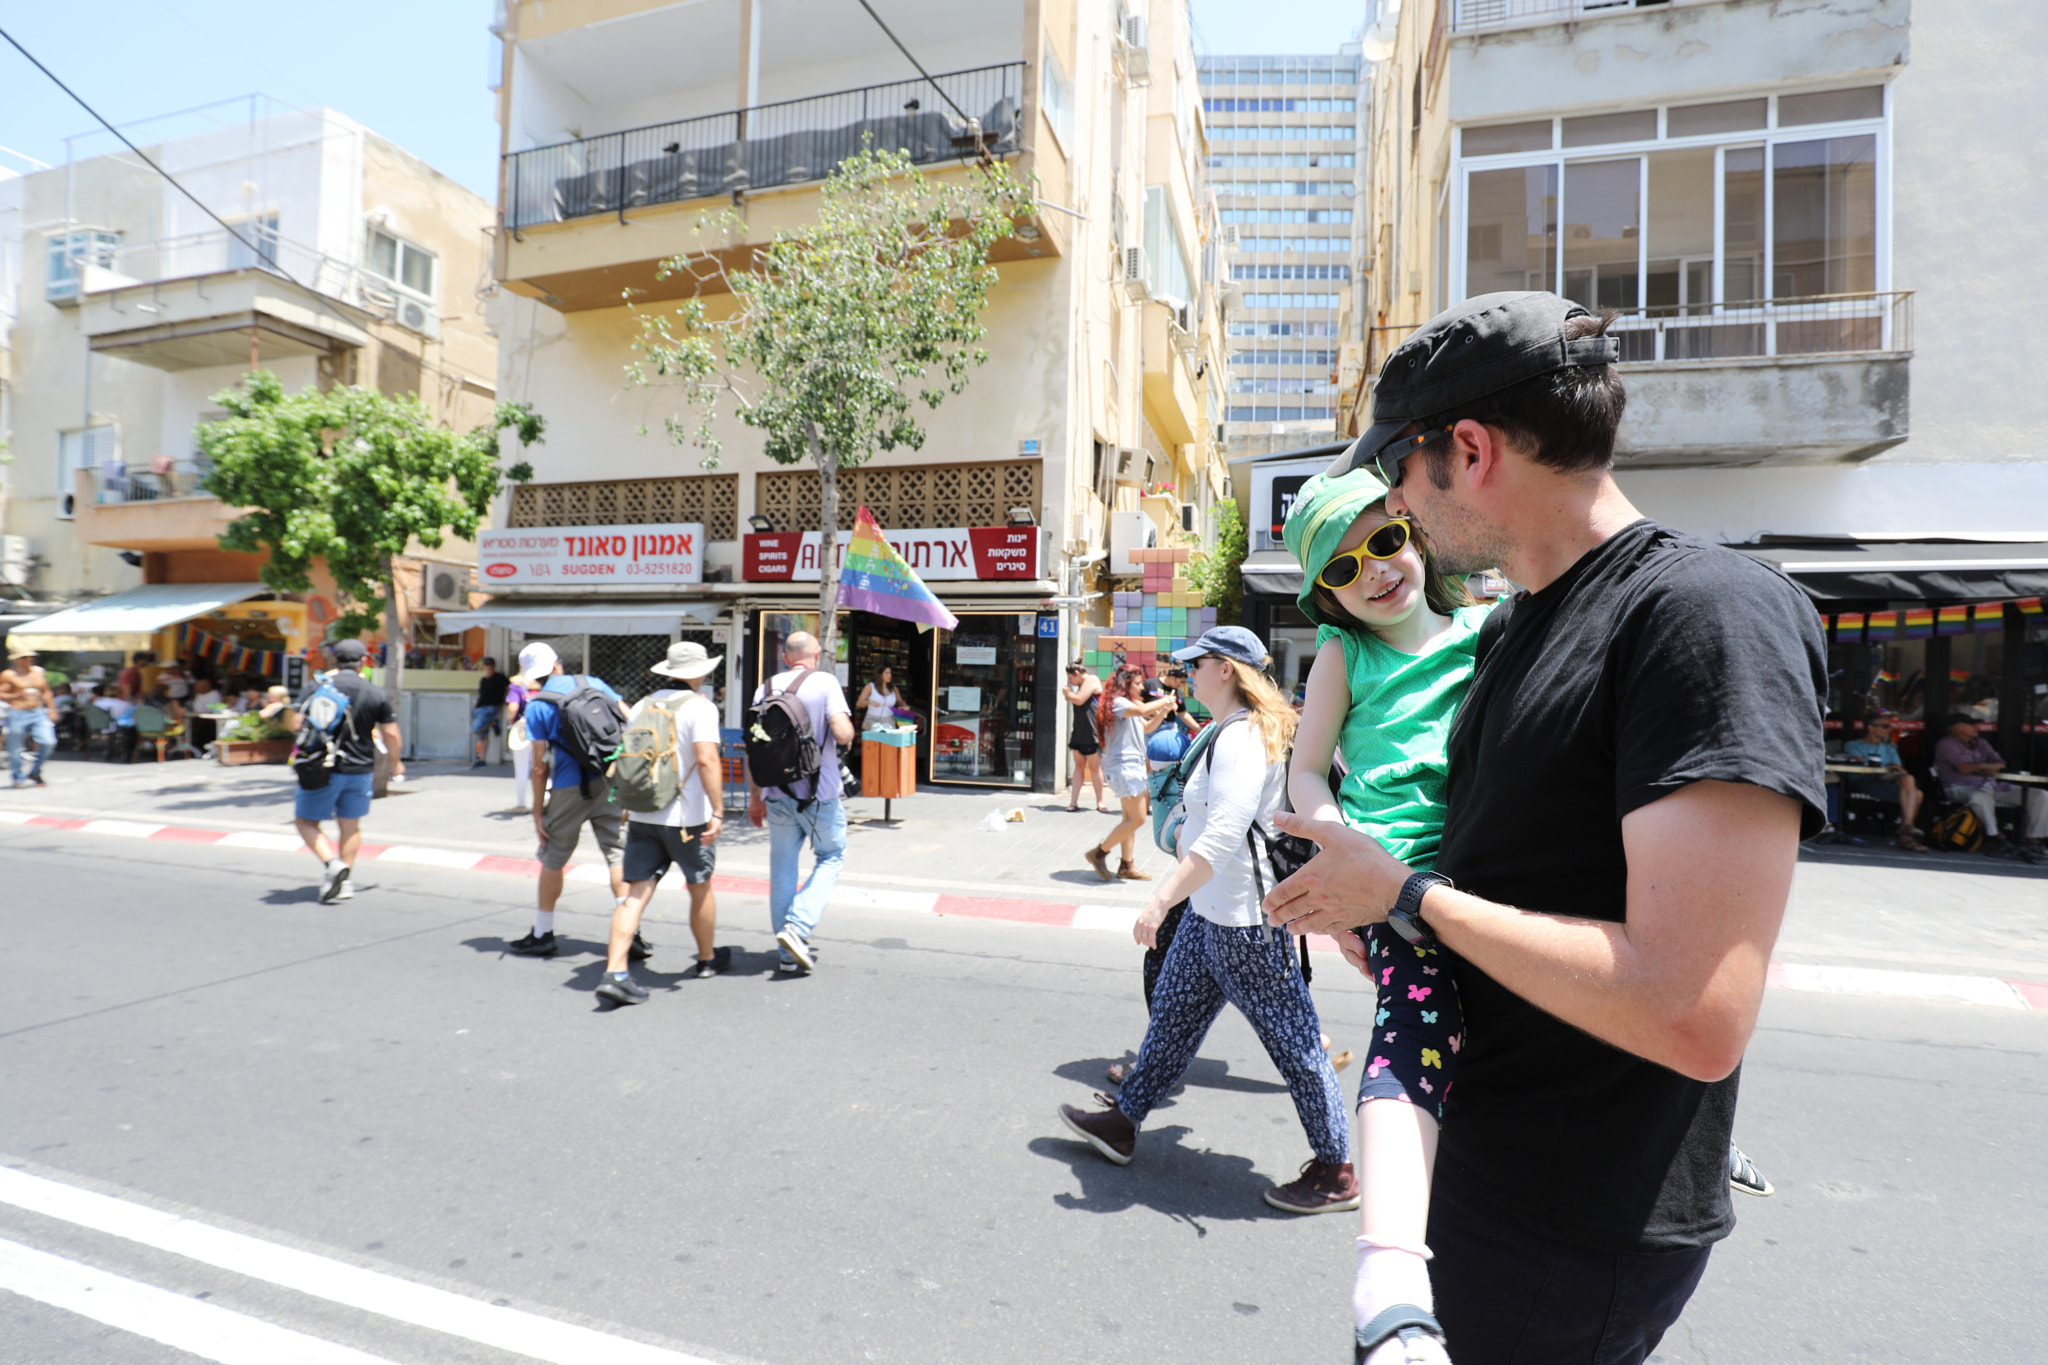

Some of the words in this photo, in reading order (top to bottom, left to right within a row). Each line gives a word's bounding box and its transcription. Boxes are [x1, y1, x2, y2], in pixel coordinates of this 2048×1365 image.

[758, 539, 779, 548] WINE
[1006, 534, 1027, 544] יינות
[564, 536, 627, 557] סאונד
[633, 534, 693, 562] אמנון
[758, 552, 788, 561] SPIRITS
[987, 548, 1027, 559] משקאות
[562, 564, 615, 575] SUGDEN
[626, 563, 693, 575] 03-5251820
[758, 565, 787, 573] CIGARS
[996, 562, 1026, 572] סיגרים
[1040, 621, 1056, 633] 41
